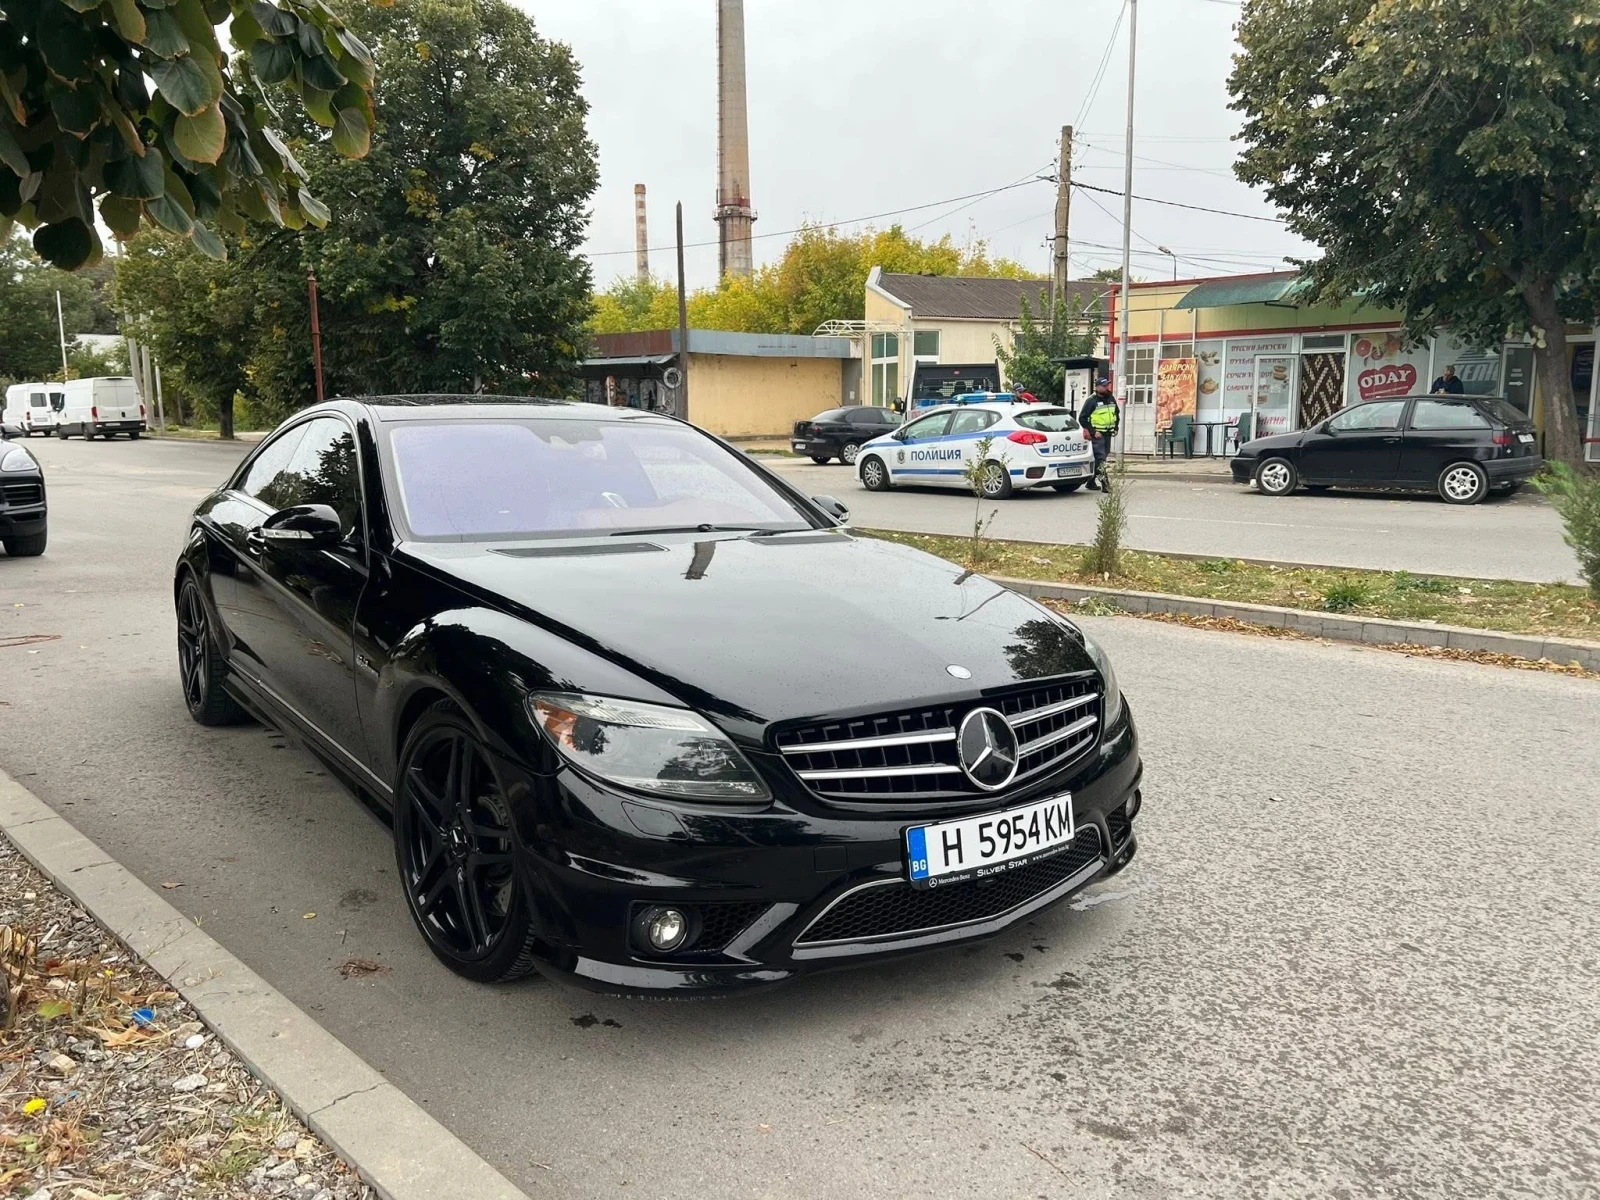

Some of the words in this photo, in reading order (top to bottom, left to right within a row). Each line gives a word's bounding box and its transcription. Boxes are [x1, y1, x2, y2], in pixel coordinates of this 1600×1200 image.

[1360, 370, 1411, 388] O'DAY
[911, 449, 962, 461] ПОЛИЦИЯ
[1052, 442, 1082, 453] POLICE
[942, 828, 963, 867] H
[912, 859, 927, 873] BG
[977, 864, 1006, 877] SILVER
[1008, 858, 1028, 870] STAR
